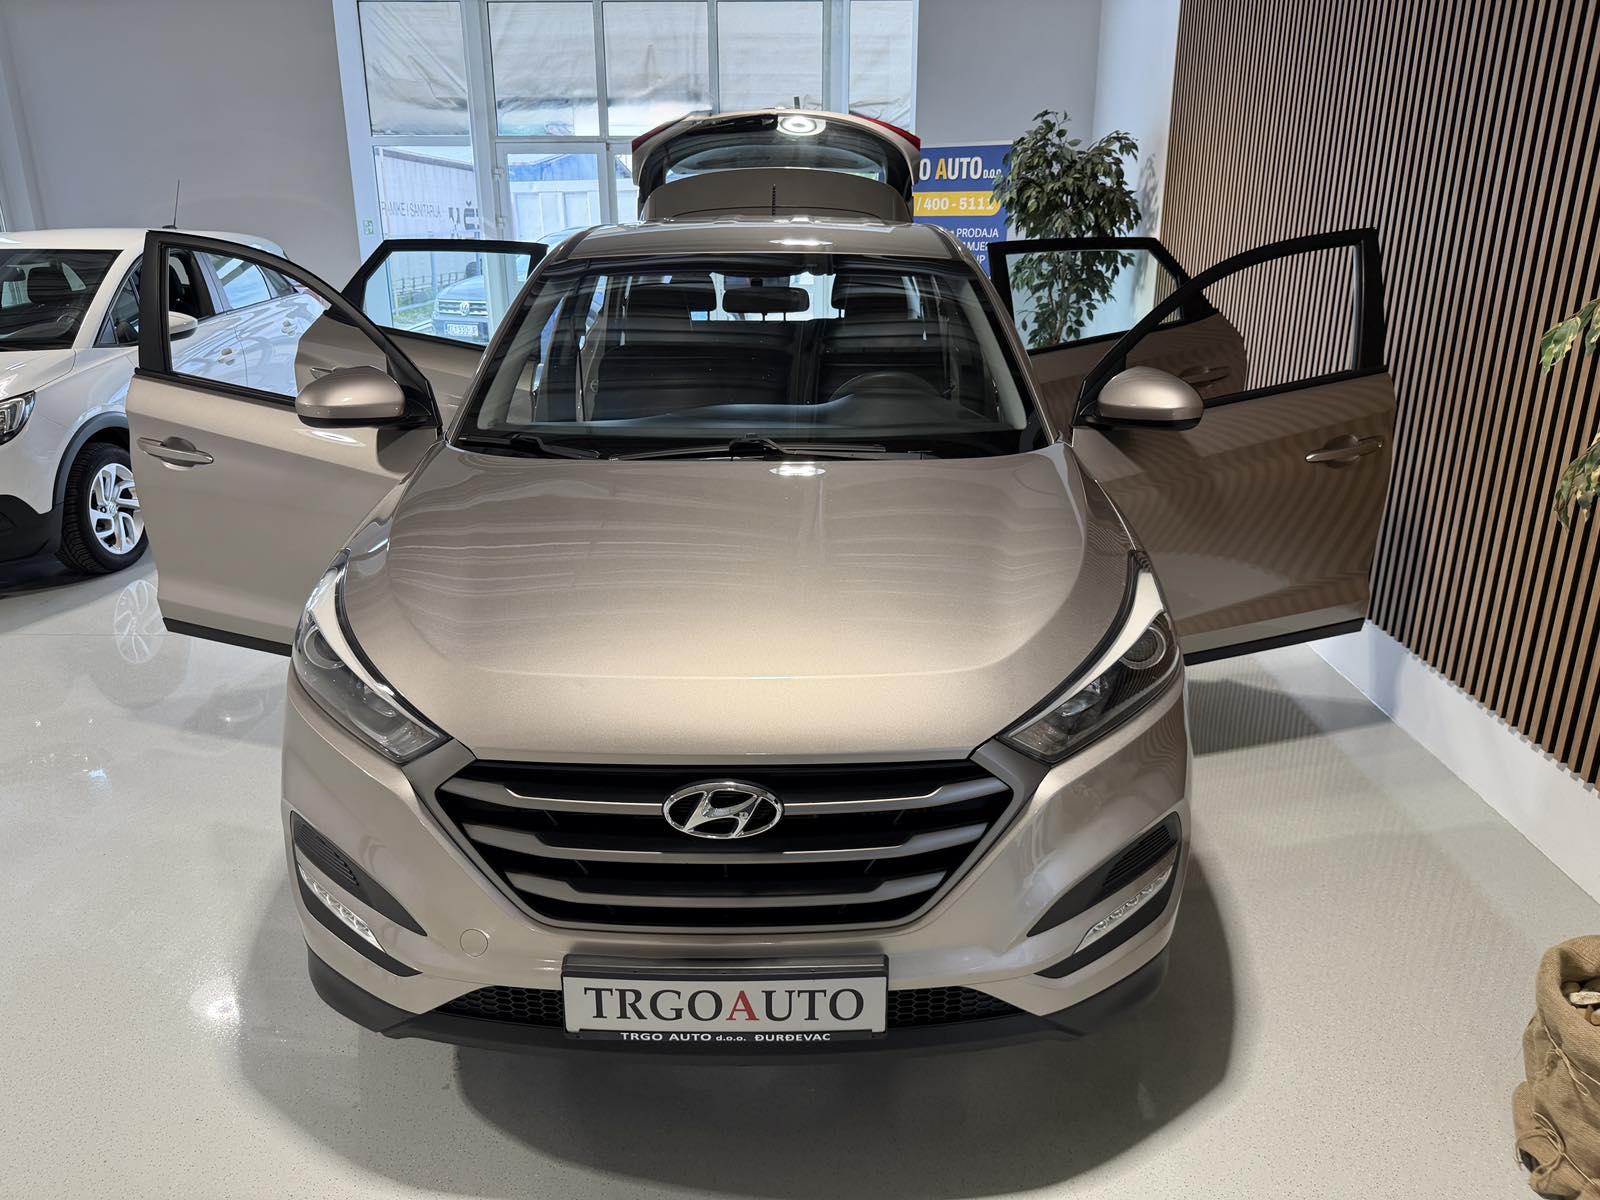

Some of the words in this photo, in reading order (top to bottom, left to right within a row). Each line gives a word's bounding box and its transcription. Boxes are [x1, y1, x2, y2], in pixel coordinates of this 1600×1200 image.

[935, 156, 983, 181] AUTO
[956, 227, 999, 238] PRODAJA
[583, 986, 865, 1022] TRGOAUTO
[620, 1032, 663, 1042] TRGO
[668, 1032, 712, 1042] AUTO
[715, 1032, 747, 1042] d.o.o.
[754, 1033, 831, 1042] ĐURĐEVAC
